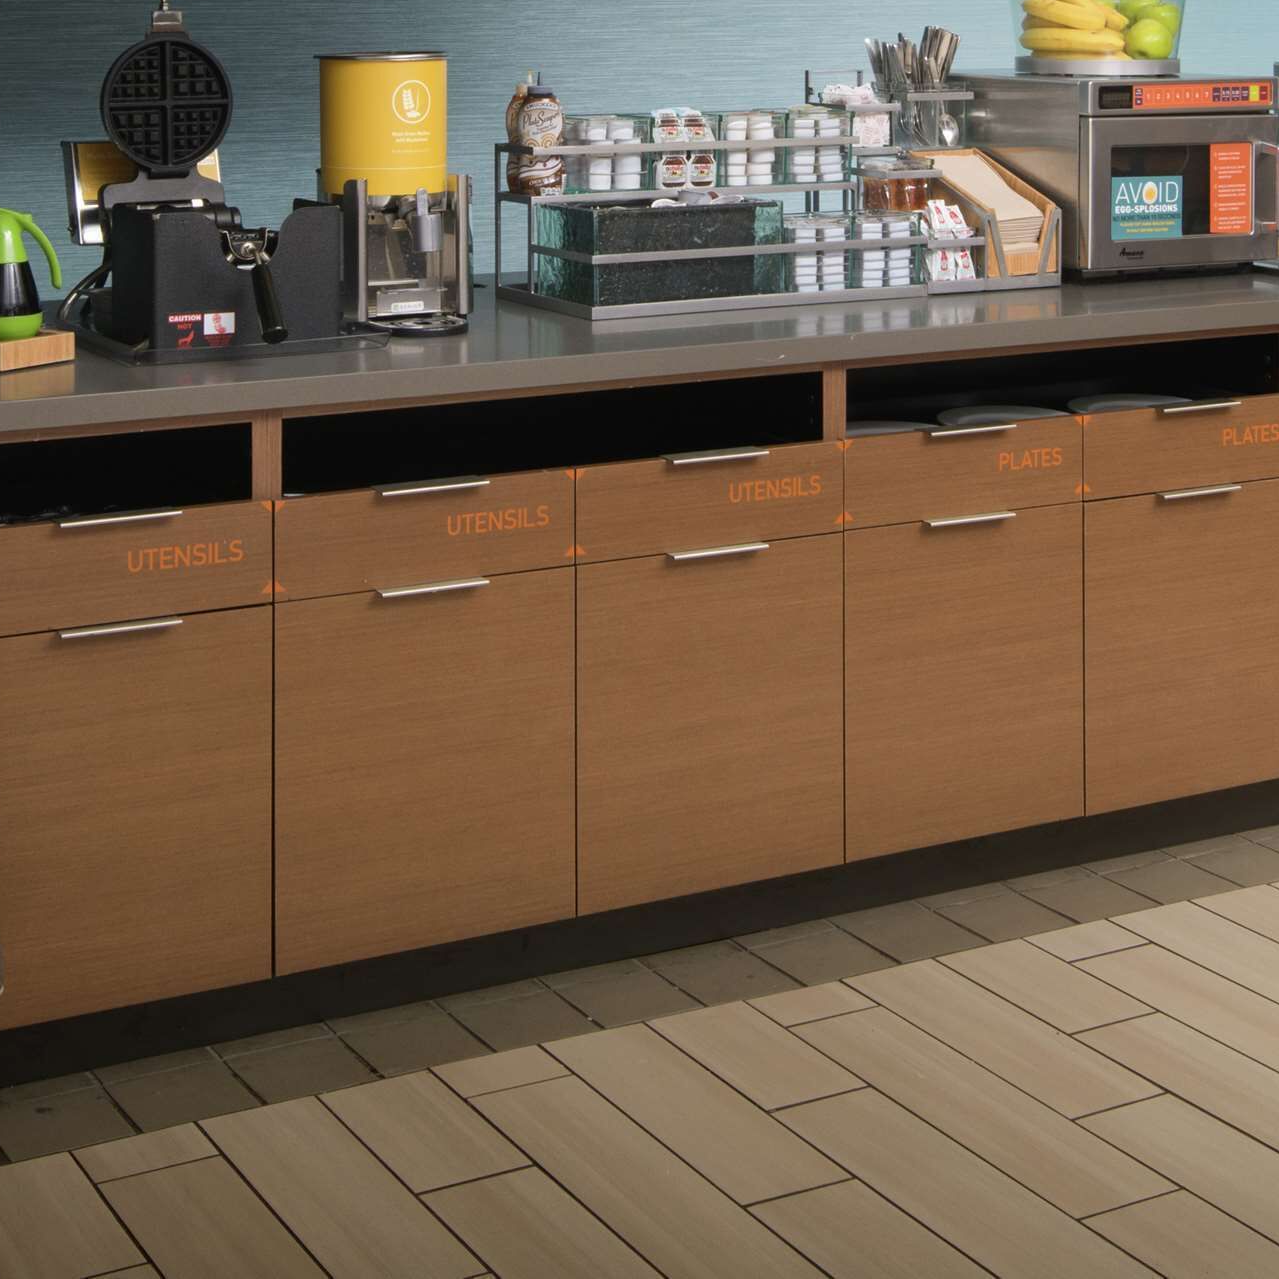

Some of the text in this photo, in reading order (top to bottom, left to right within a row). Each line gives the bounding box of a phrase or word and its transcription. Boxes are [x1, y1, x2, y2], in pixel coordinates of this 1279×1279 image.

[1115, 181, 1179, 204] AVOID
[1114, 204, 1178, 214] EGG-SPLOSIONS
[168, 314, 202, 323] CAUTION
[998, 447, 1063, 472] PLATES
[728, 476, 822, 504] UTENSILS
[446, 505, 550, 537] UTENSILS
[126, 539, 246, 573] UTENSILS
